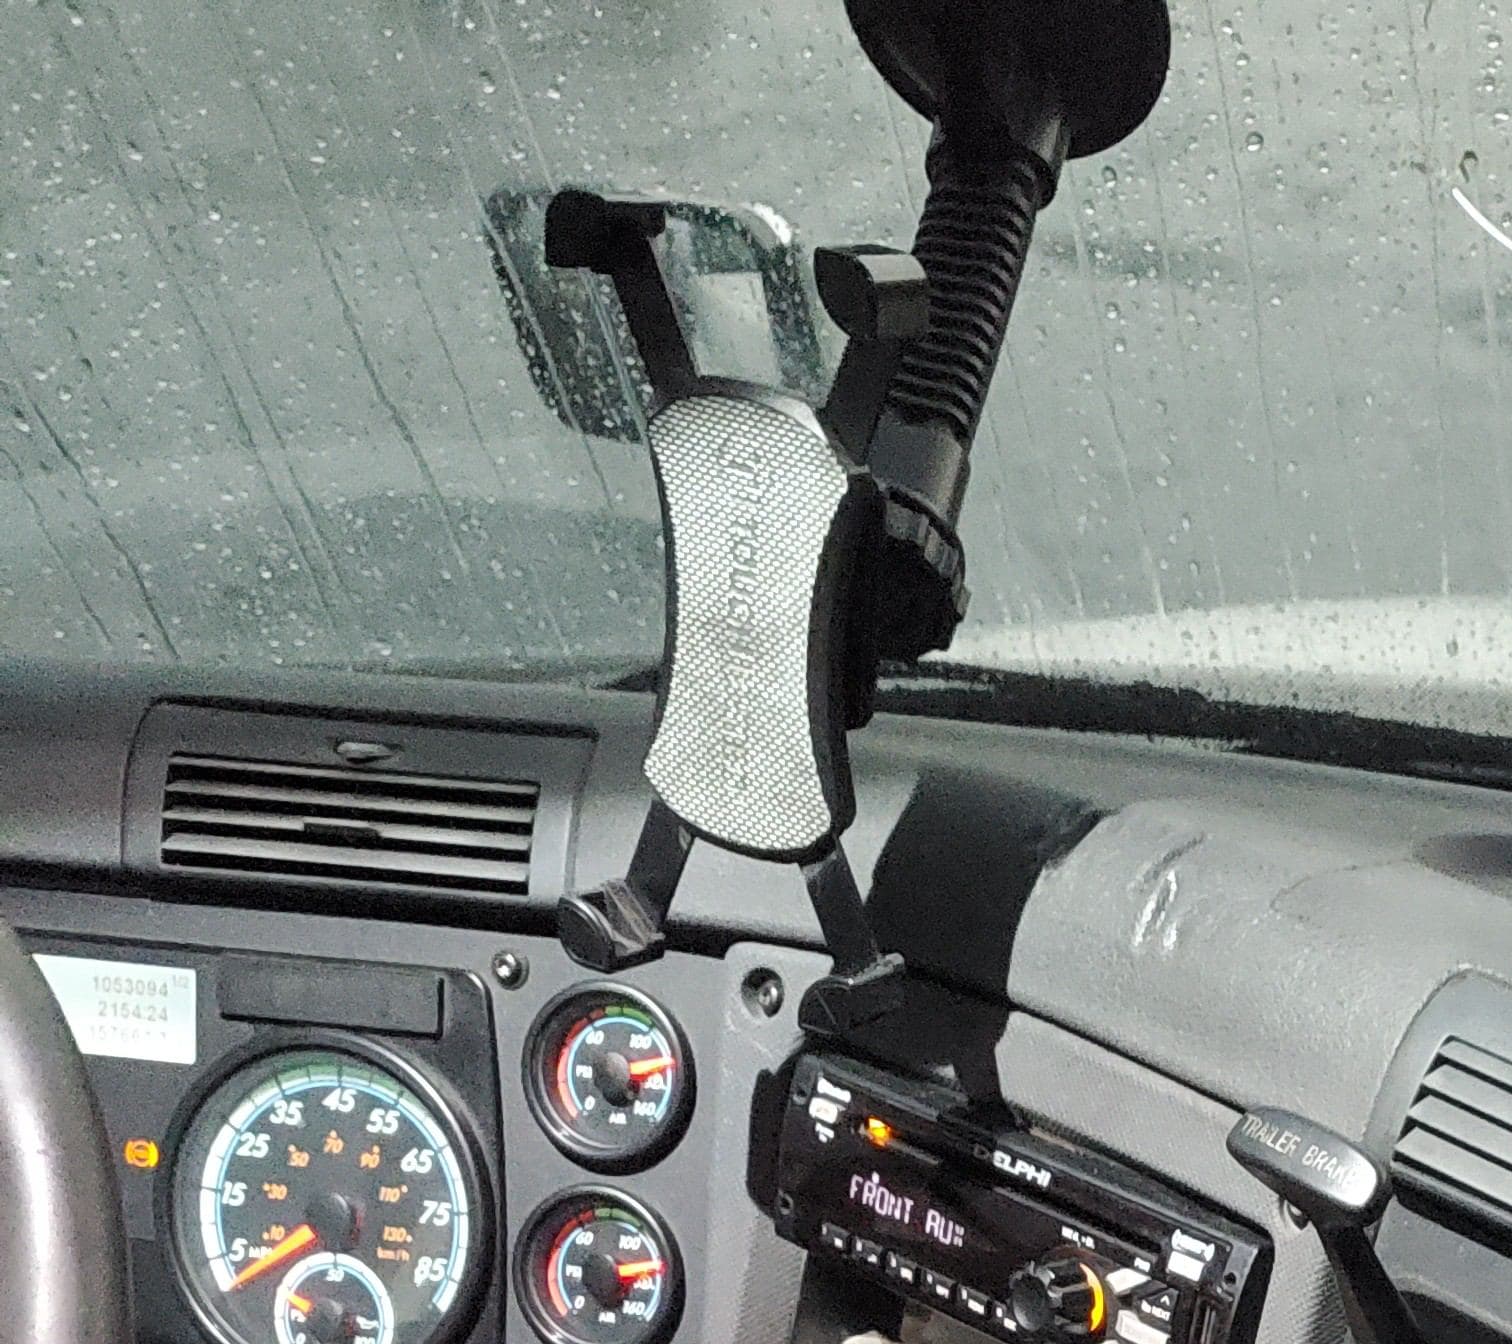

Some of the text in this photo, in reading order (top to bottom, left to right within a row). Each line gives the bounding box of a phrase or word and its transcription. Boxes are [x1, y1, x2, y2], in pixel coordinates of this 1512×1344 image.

[269, 1100, 303, 1125] 35
[321, 1088, 357, 1112] 45
[366, 1108, 400, 1134] 55
[236, 1133, 270, 1158] 25
[1241, 1115, 1301, 1158] TRAILER
[400, 1148, 434, 1173] 65
[222, 1181, 248, 1206] 15
[849, 1175, 914, 1225] FRONT
[419, 1200, 452, 1226] 75
[228, 1238, 249, 1262] 5
[619, 1235, 642, 1251] 100
[414, 1256, 448, 1282] 85
